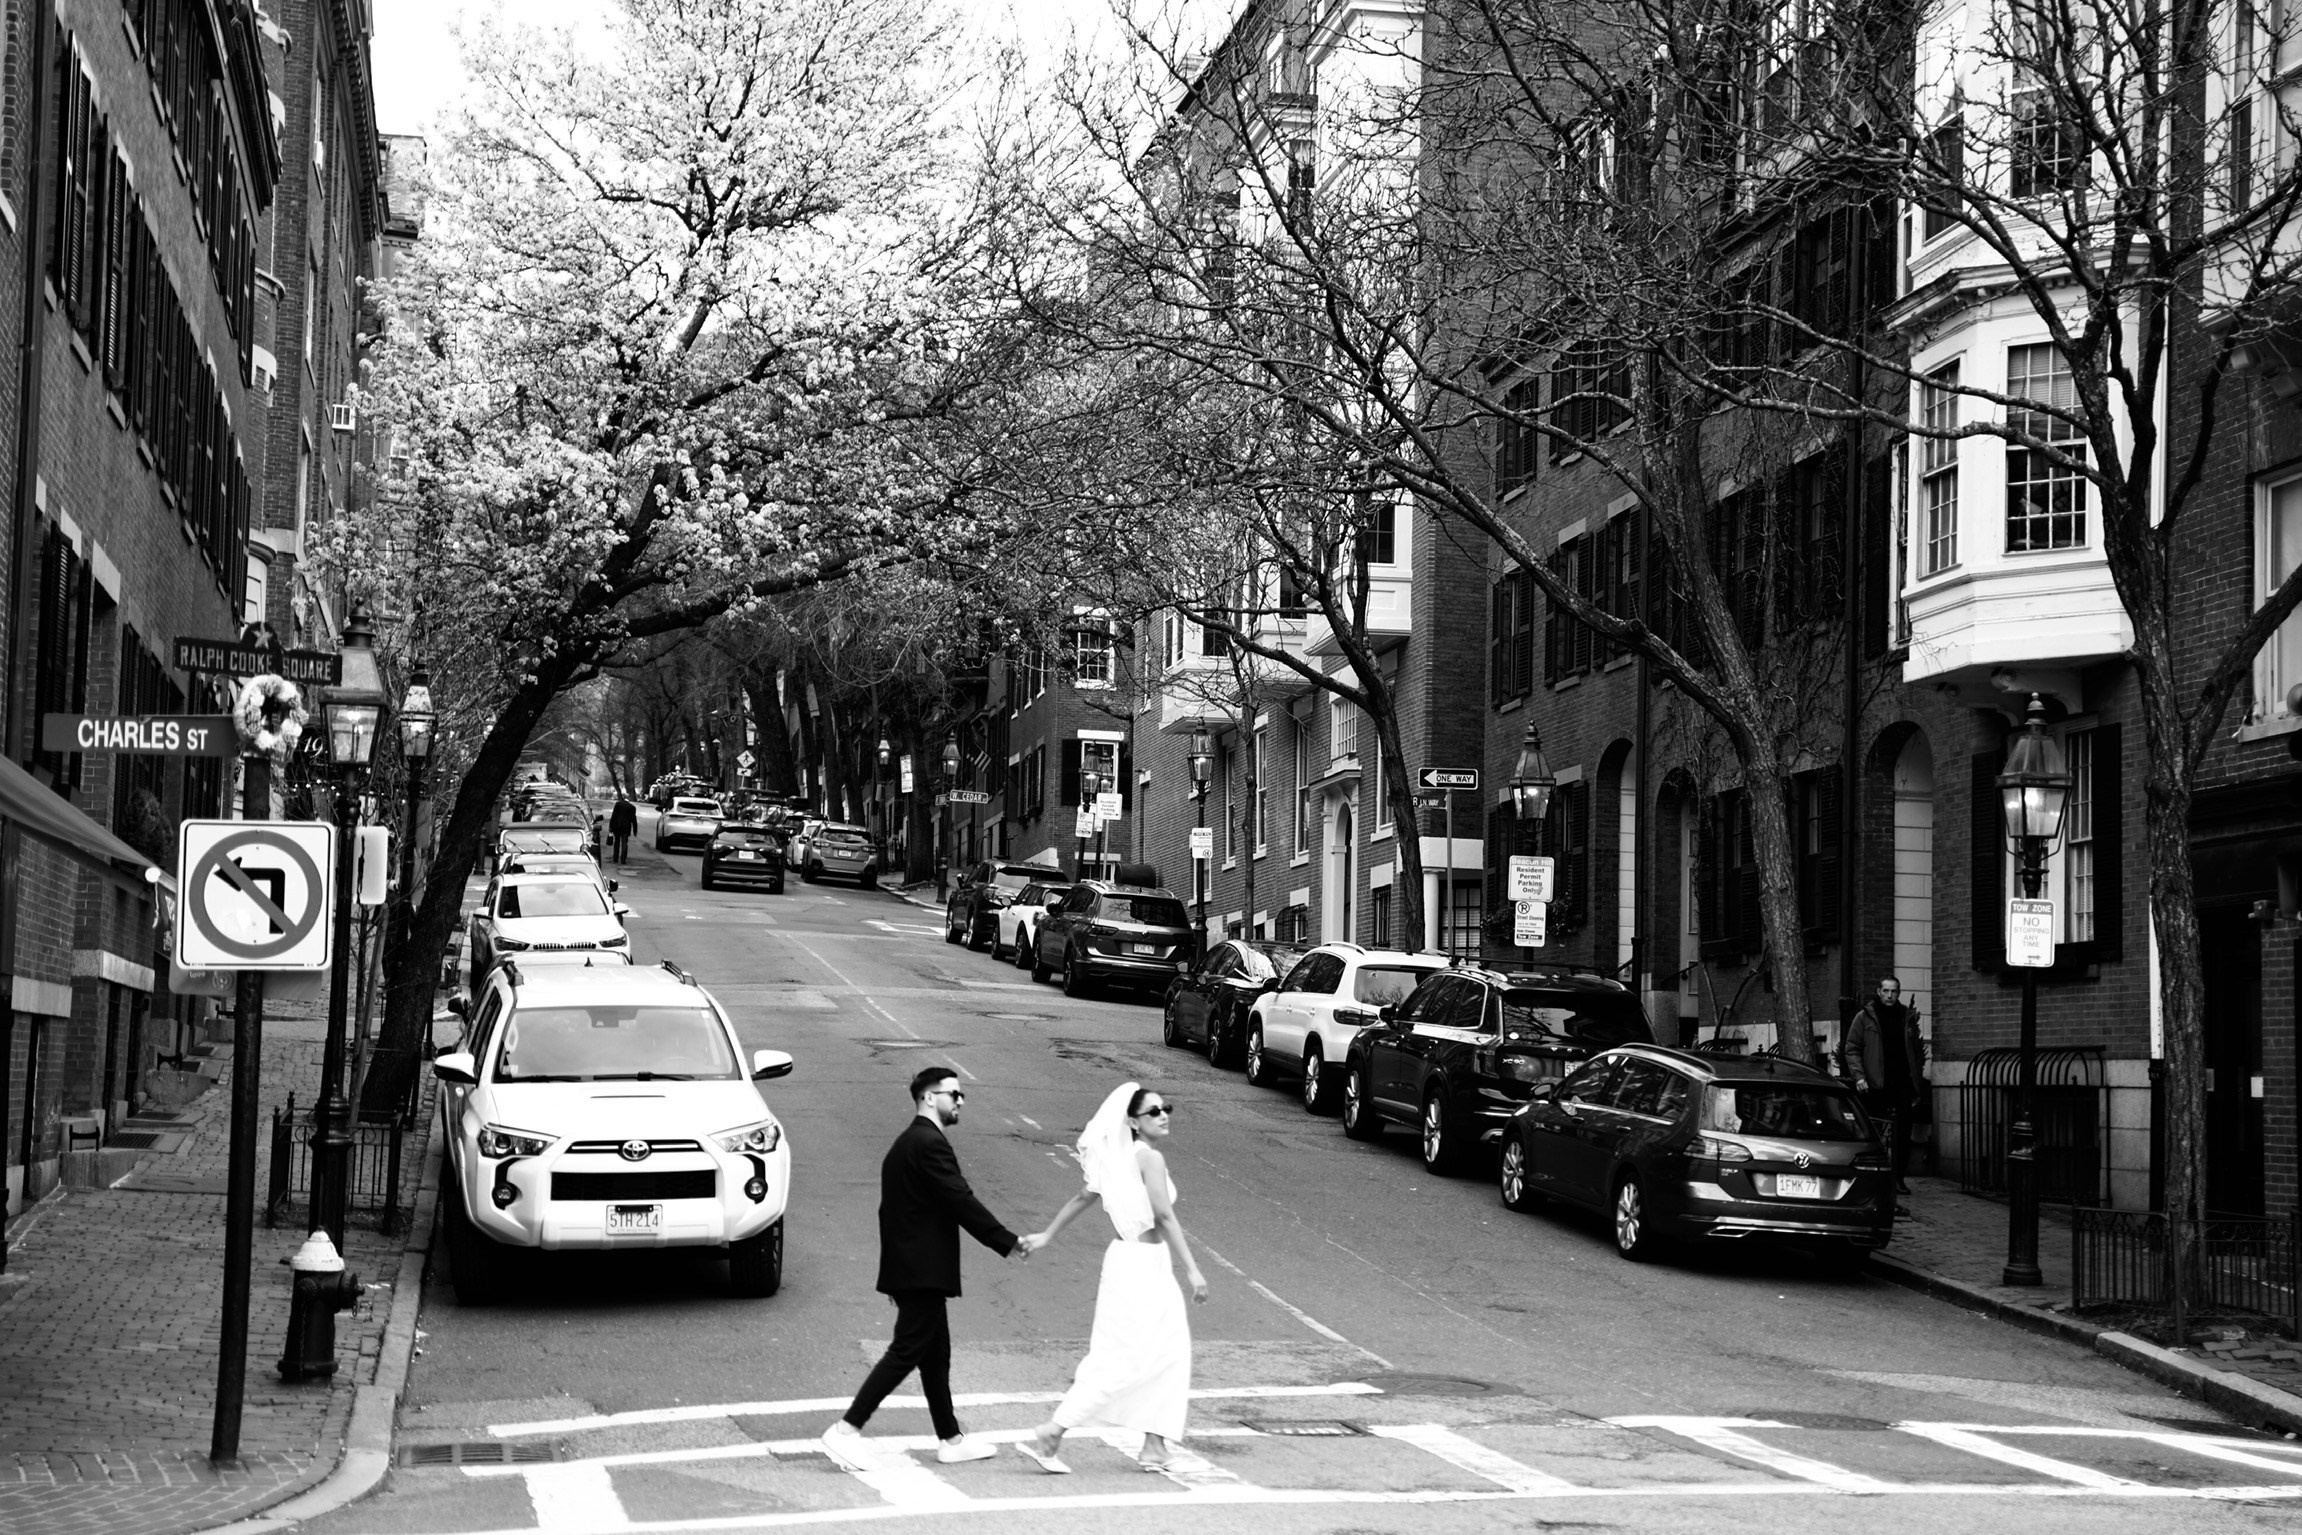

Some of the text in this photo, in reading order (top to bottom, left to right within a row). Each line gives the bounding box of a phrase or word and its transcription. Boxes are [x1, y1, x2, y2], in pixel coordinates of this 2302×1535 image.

[180, 645, 332, 681] RALPH COOKE SQUARE
[77, 719, 208, 750] CHARLES ST
[1455, 775, 1471, 783] WAY
[952, 791, 960, 800] W.
[962, 792, 982, 802] CEDAR
[1428, 799, 1439, 807] WAY
[2012, 903, 2051, 912] TOW ZONE
[2023, 917, 2040, 927] NO
[1806, 1181, 1818, 1193] 77
[636, 1212, 658, 1227] 214
